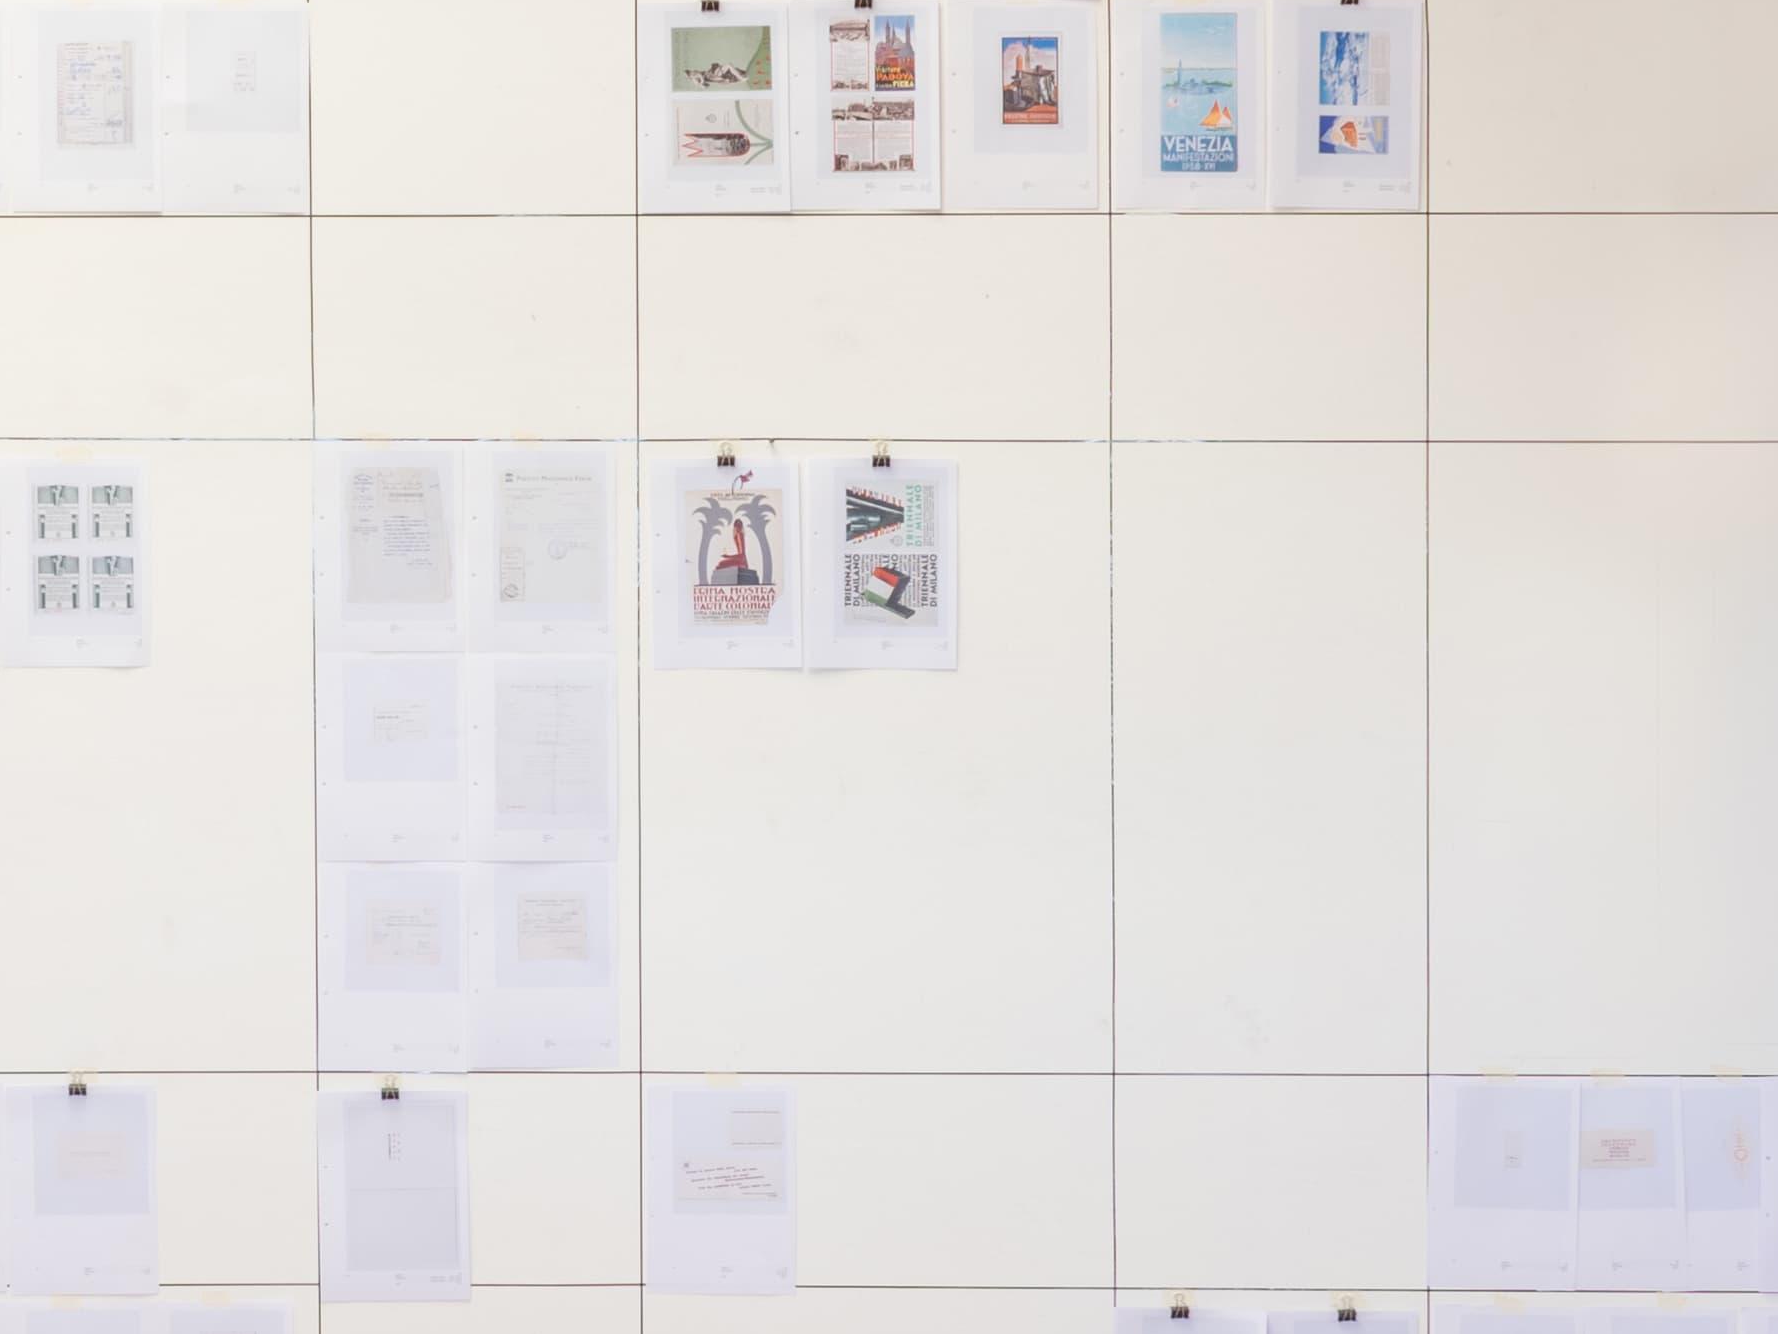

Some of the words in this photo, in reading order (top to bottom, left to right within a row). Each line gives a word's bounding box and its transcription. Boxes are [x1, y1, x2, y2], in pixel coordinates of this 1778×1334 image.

[1163, 136, 1233, 152] VENEZIA
[914, 484, 922, 531] MILANO
[914, 535, 922, 547] DI
[844, 554, 852, 607] TRIENNALE
[921, 554, 929, 607] TRIENNALE
[853, 596, 860, 607] DI
[930, 596, 937, 607] DI
